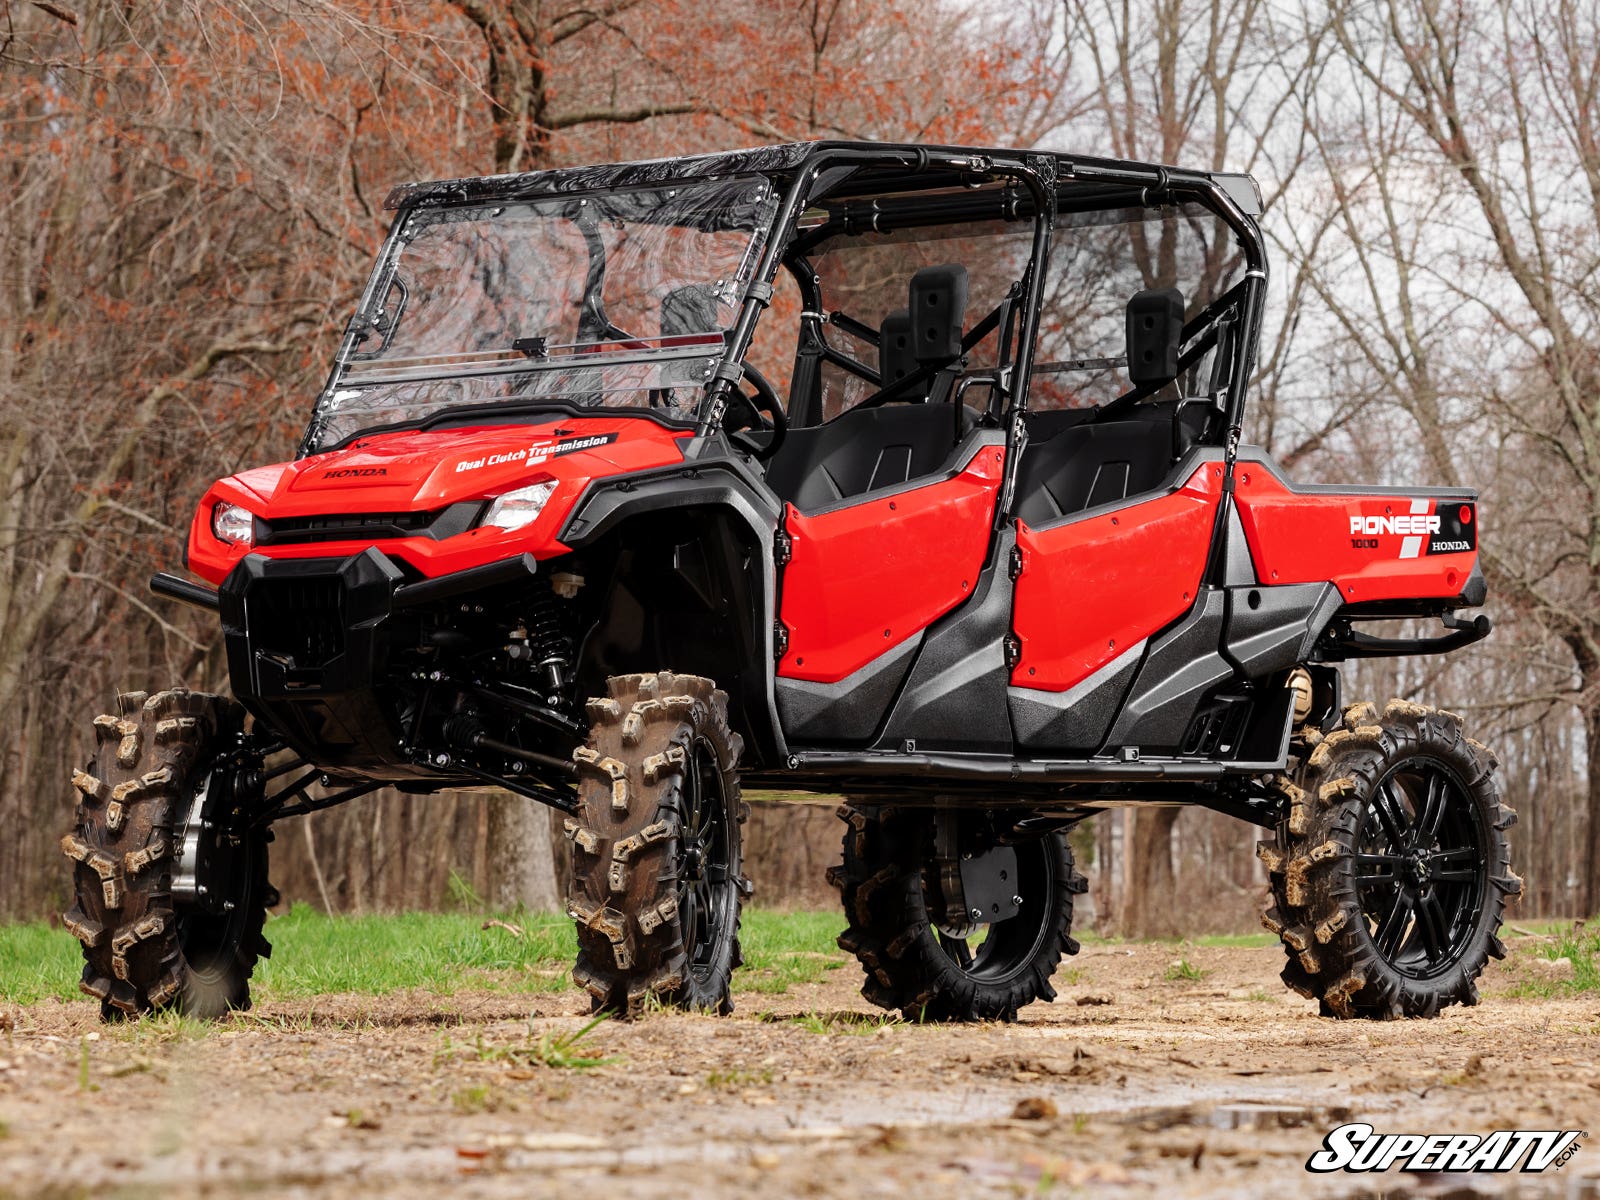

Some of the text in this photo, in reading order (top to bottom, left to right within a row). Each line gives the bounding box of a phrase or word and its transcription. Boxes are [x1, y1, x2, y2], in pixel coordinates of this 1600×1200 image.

[456, 436, 608, 472] Dual Clutch Transmission
[323, 468, 387, 479] HONDA
[1350, 515, 1441, 535] PIONEER
[1351, 538, 1378, 549] 1000
[1432, 540, 1470, 551] HONDA
